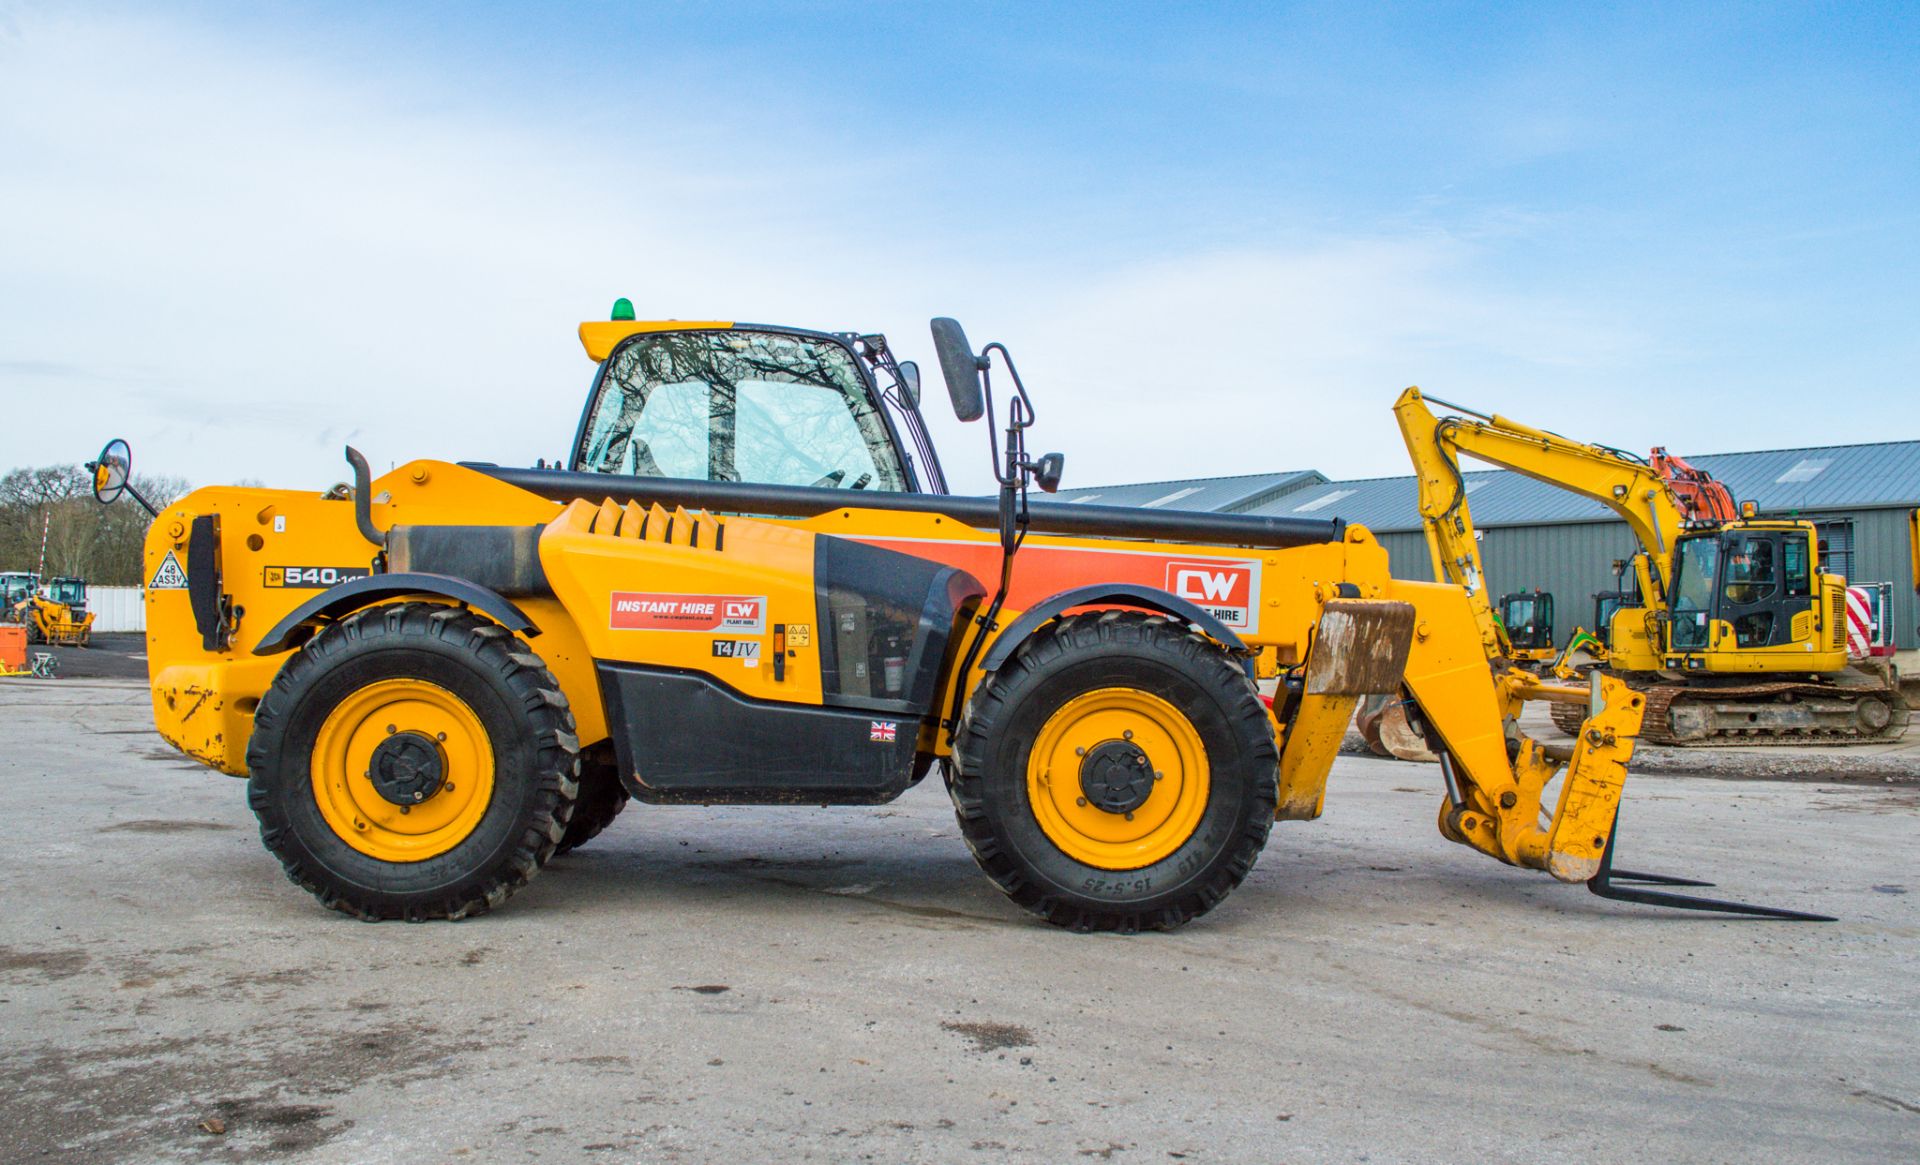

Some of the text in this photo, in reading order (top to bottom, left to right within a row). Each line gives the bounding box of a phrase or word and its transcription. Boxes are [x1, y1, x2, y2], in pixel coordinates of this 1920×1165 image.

[164, 564, 176, 574] 48
[158, 574, 182, 585] AS3Y
[1176, 569, 1239, 602] CW
[616, 600, 716, 615] INSTANT HIRE
[726, 602, 754, 617] CW
[1213, 609, 1239, 621] HIRE
[714, 641, 758, 657] T4 IV
[1082, 877, 1152, 895] 15.5-25
